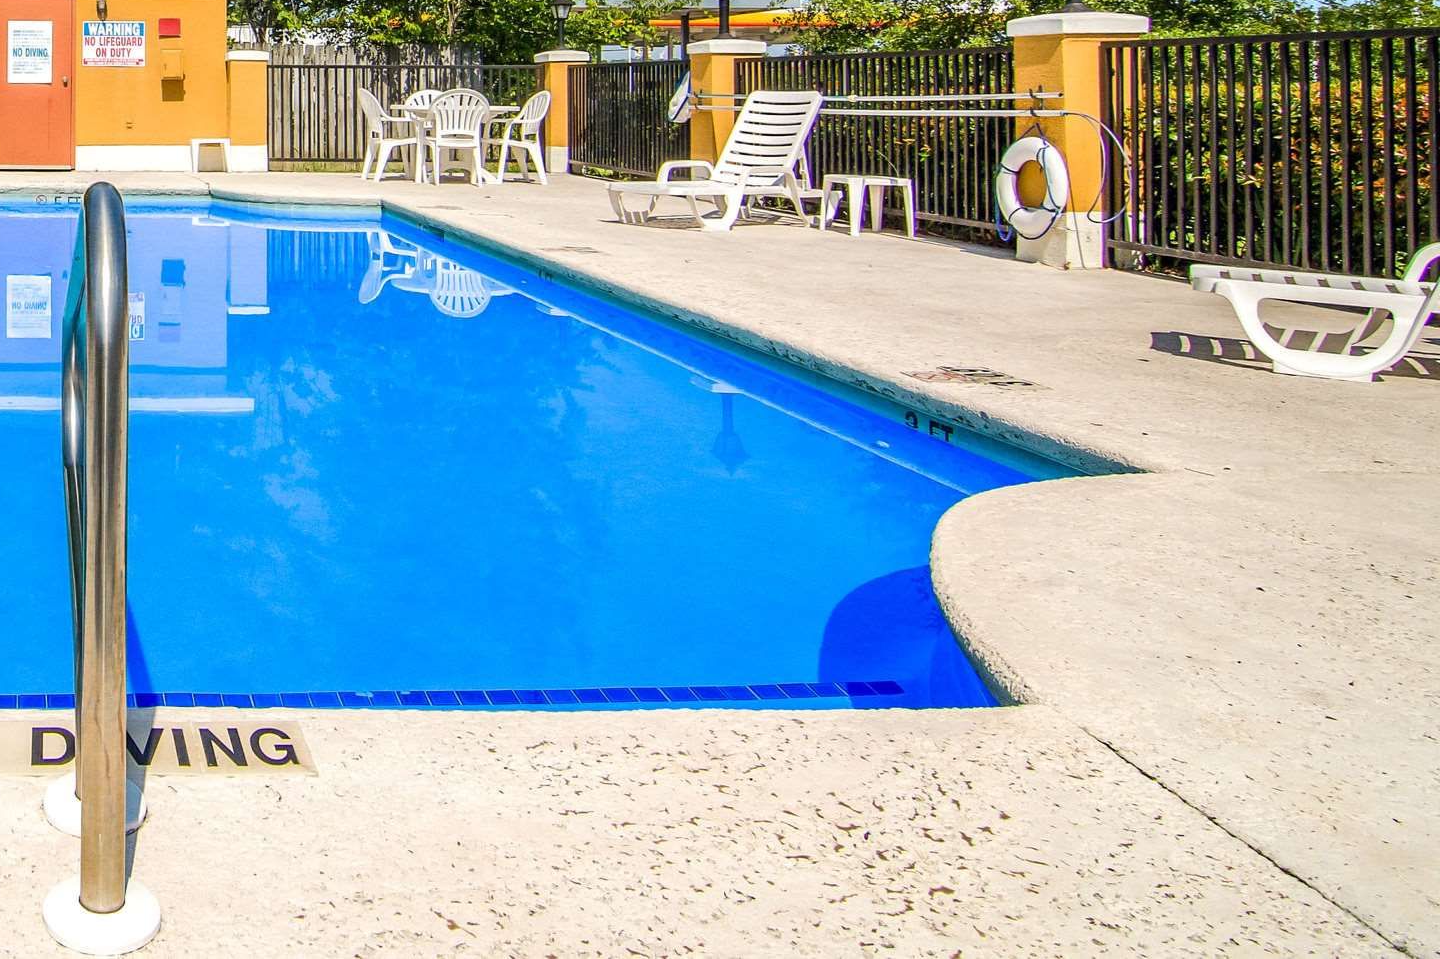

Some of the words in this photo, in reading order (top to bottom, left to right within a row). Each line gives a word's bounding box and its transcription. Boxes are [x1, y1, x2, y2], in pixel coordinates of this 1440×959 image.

[88, 23, 140, 36] WARNING
[84, 37, 96, 47] NO
[99, 37, 143, 47] LIFEGUARD
[12, 48, 23, 57] NO
[95, 48, 107, 57] ON
[110, 48, 131, 57] DUTY
[929, 420, 954, 442] FT
[31, 727, 300, 767] DVING
